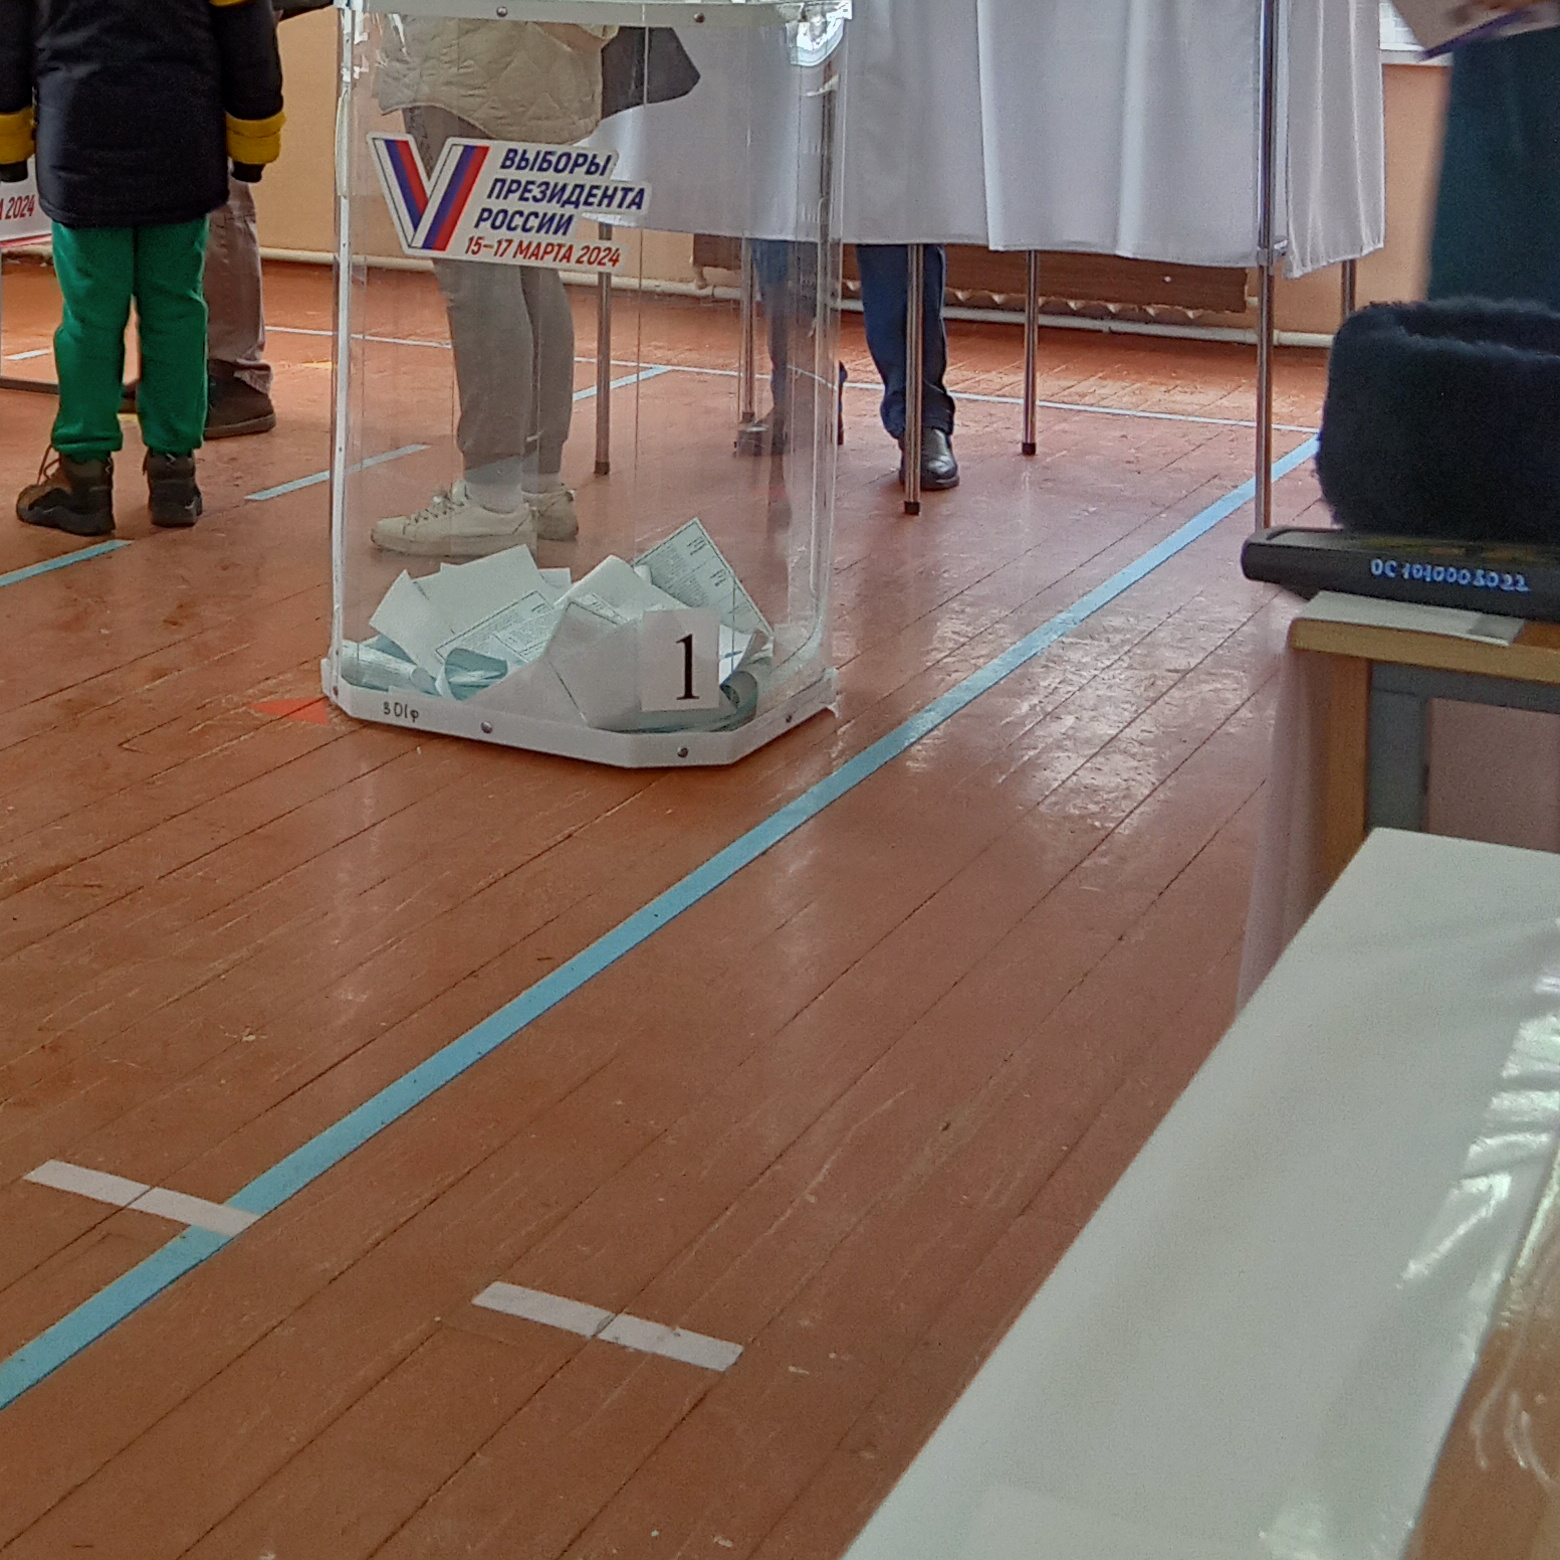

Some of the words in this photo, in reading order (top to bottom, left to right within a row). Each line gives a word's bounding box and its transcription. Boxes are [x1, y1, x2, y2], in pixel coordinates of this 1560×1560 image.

[499, 147, 612, 178] ВЫБОРЫ
[4, 194, 36, 221] 2024
[487, 176, 646, 211] ПРЕЗИДЕНТА
[474, 206, 574, 237] РОССИИ
[514, 242, 573, 265] МАРТА
[575, 245, 622, 269] 2024
[675, 633, 701, 702] 1
